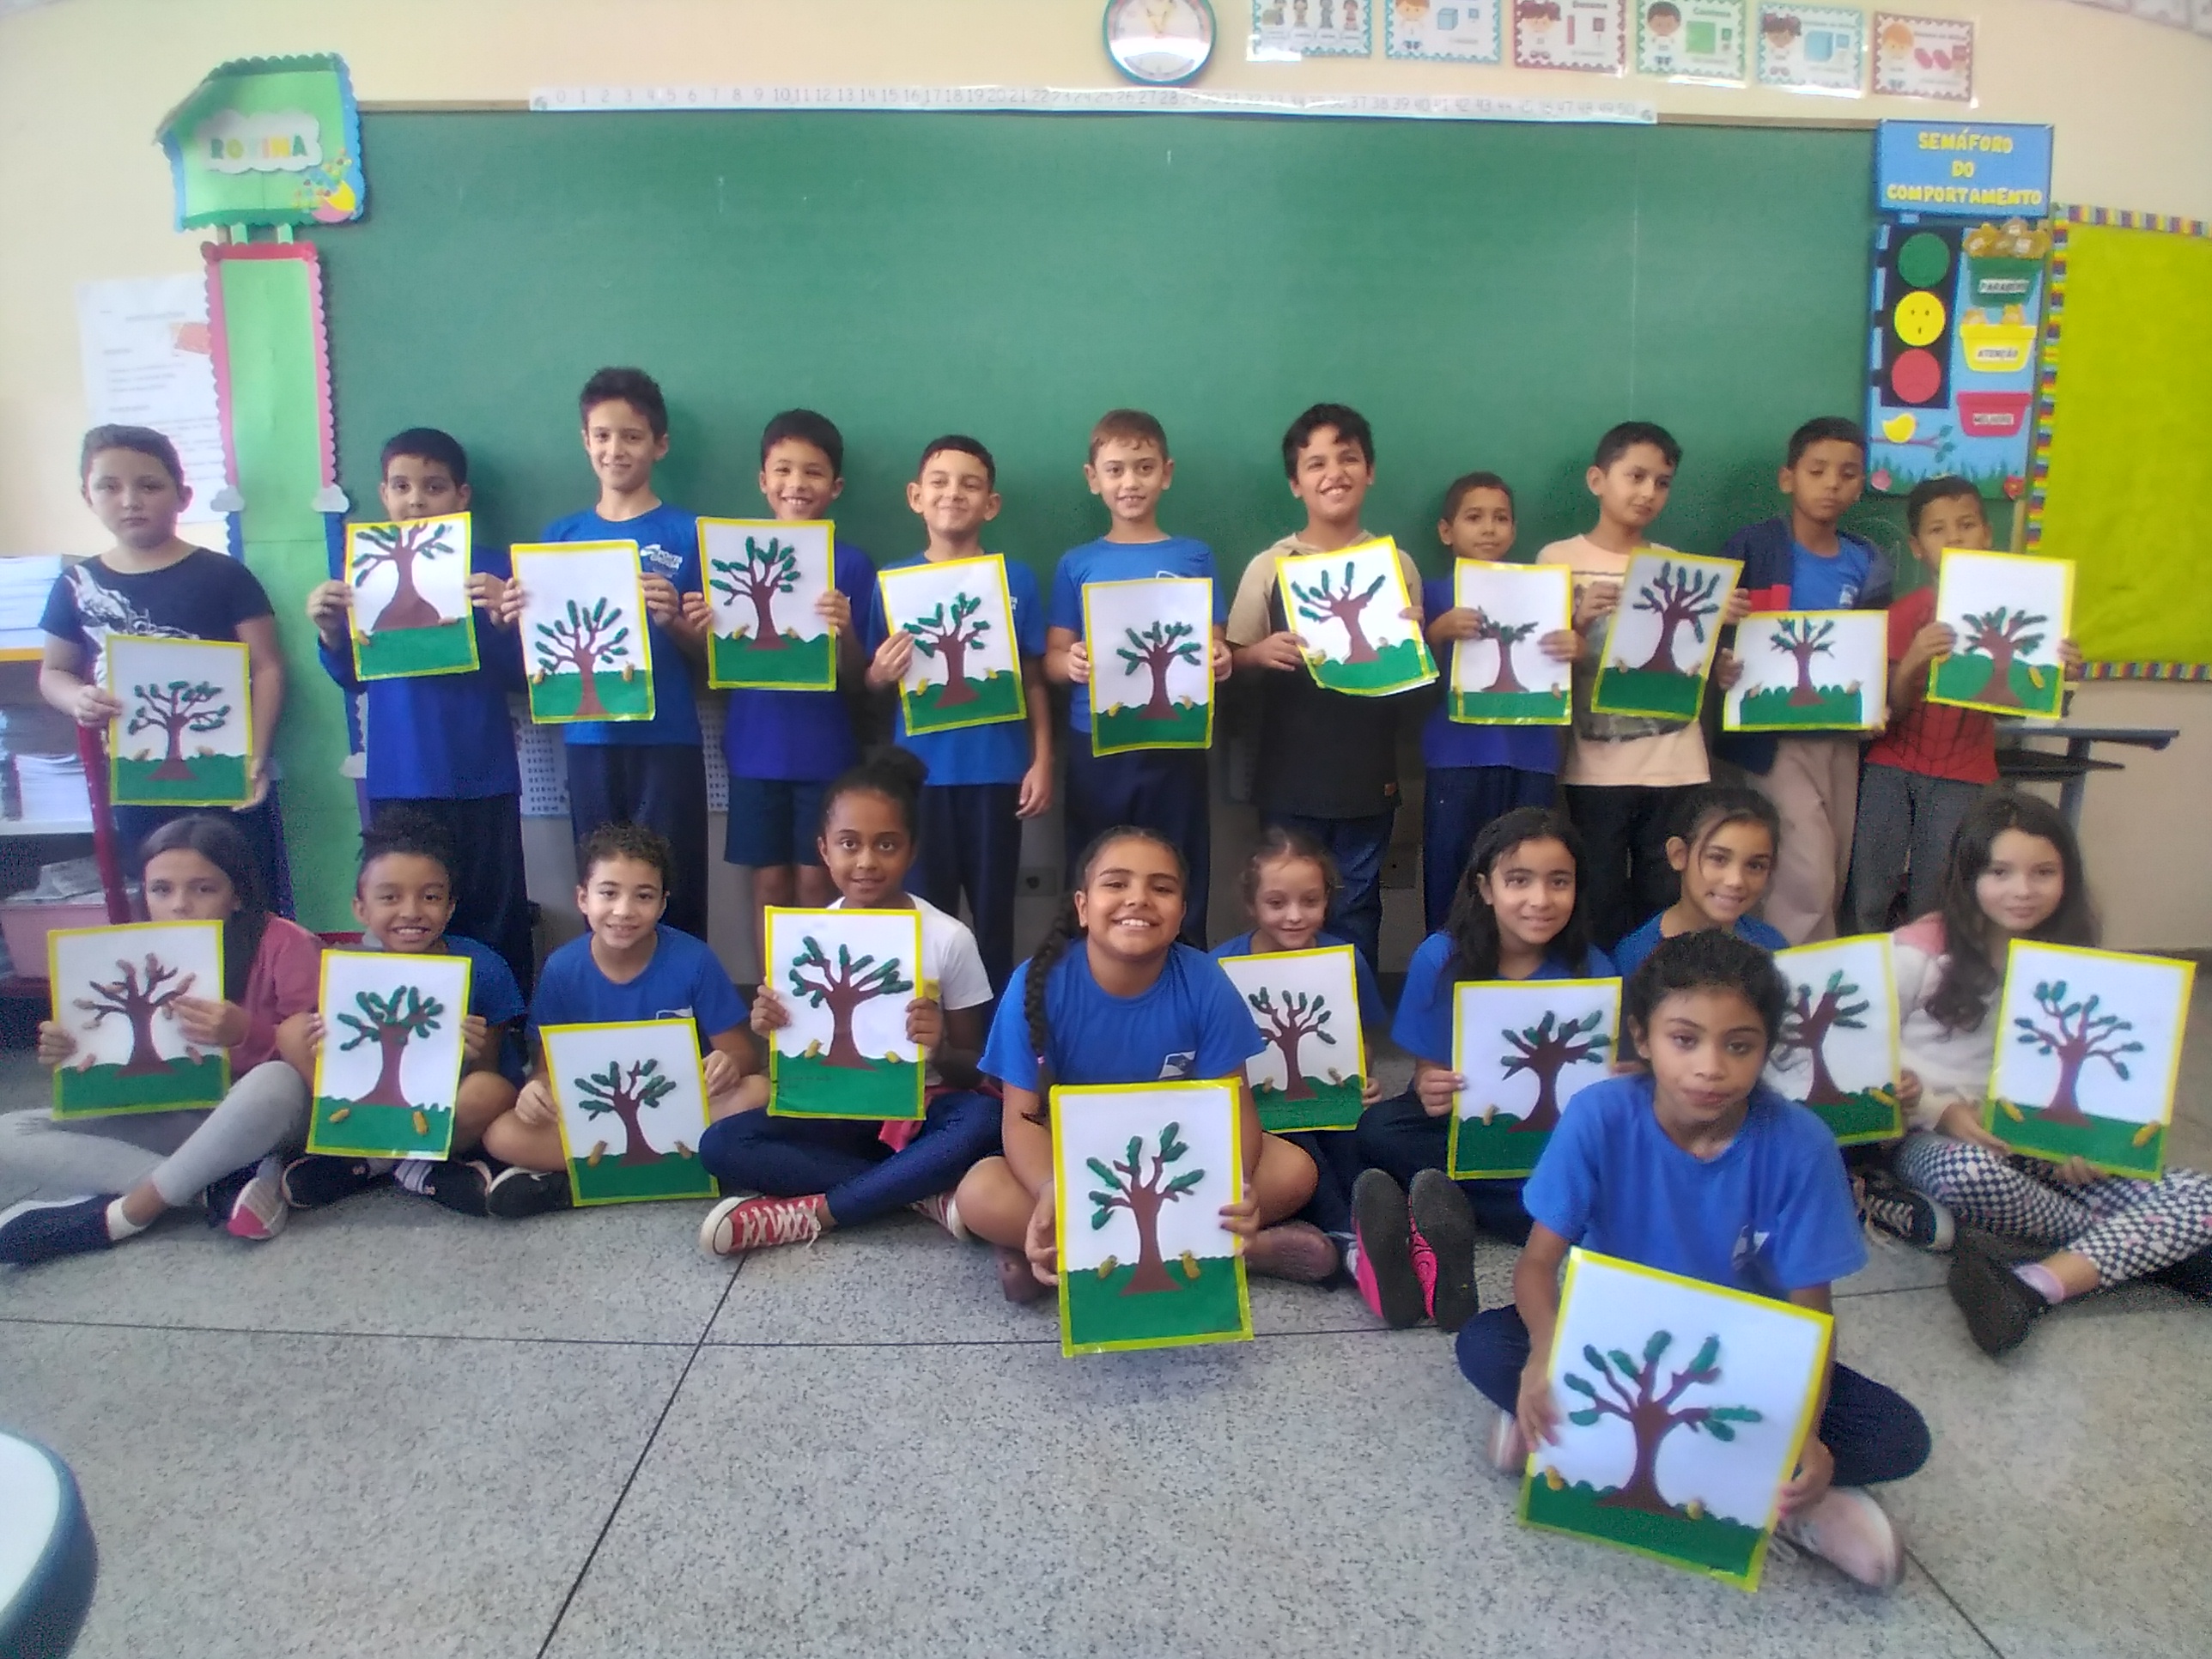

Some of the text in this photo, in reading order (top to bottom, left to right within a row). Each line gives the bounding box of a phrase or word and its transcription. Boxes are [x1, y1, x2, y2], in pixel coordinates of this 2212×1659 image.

[732, 88, 742, 102] 8
[774, 88, 791, 102] 10
[795, 88, 810, 102] 11
[817, 88, 831, 102] 12
[838, 88, 854, 102] 13
[860, 88, 875, 102] 14
[882, 88, 898, 102] 15
[904, 88, 921, 103] 16
[925, 89, 941, 103] 17
[945, 89, 963, 103] 18
[968, 88, 984, 102] 19
[988, 89, 1006, 103] 20
[1010, 89, 1026, 103] 21
[1032, 89, 1049, 103] 22
[1139, 90, 1156, 105] 27
[1159, 90, 1179, 105] 28
[1351, 95, 1367, 109] 37
[1373, 96, 1388, 109] 38
[1393, 97, 1410, 110] 39
[1917, 128, 2014, 154] SEMÁFORO
[1951, 160, 1974, 178] DO
[1887, 184, 2042, 206] COMPORTAMENTO
